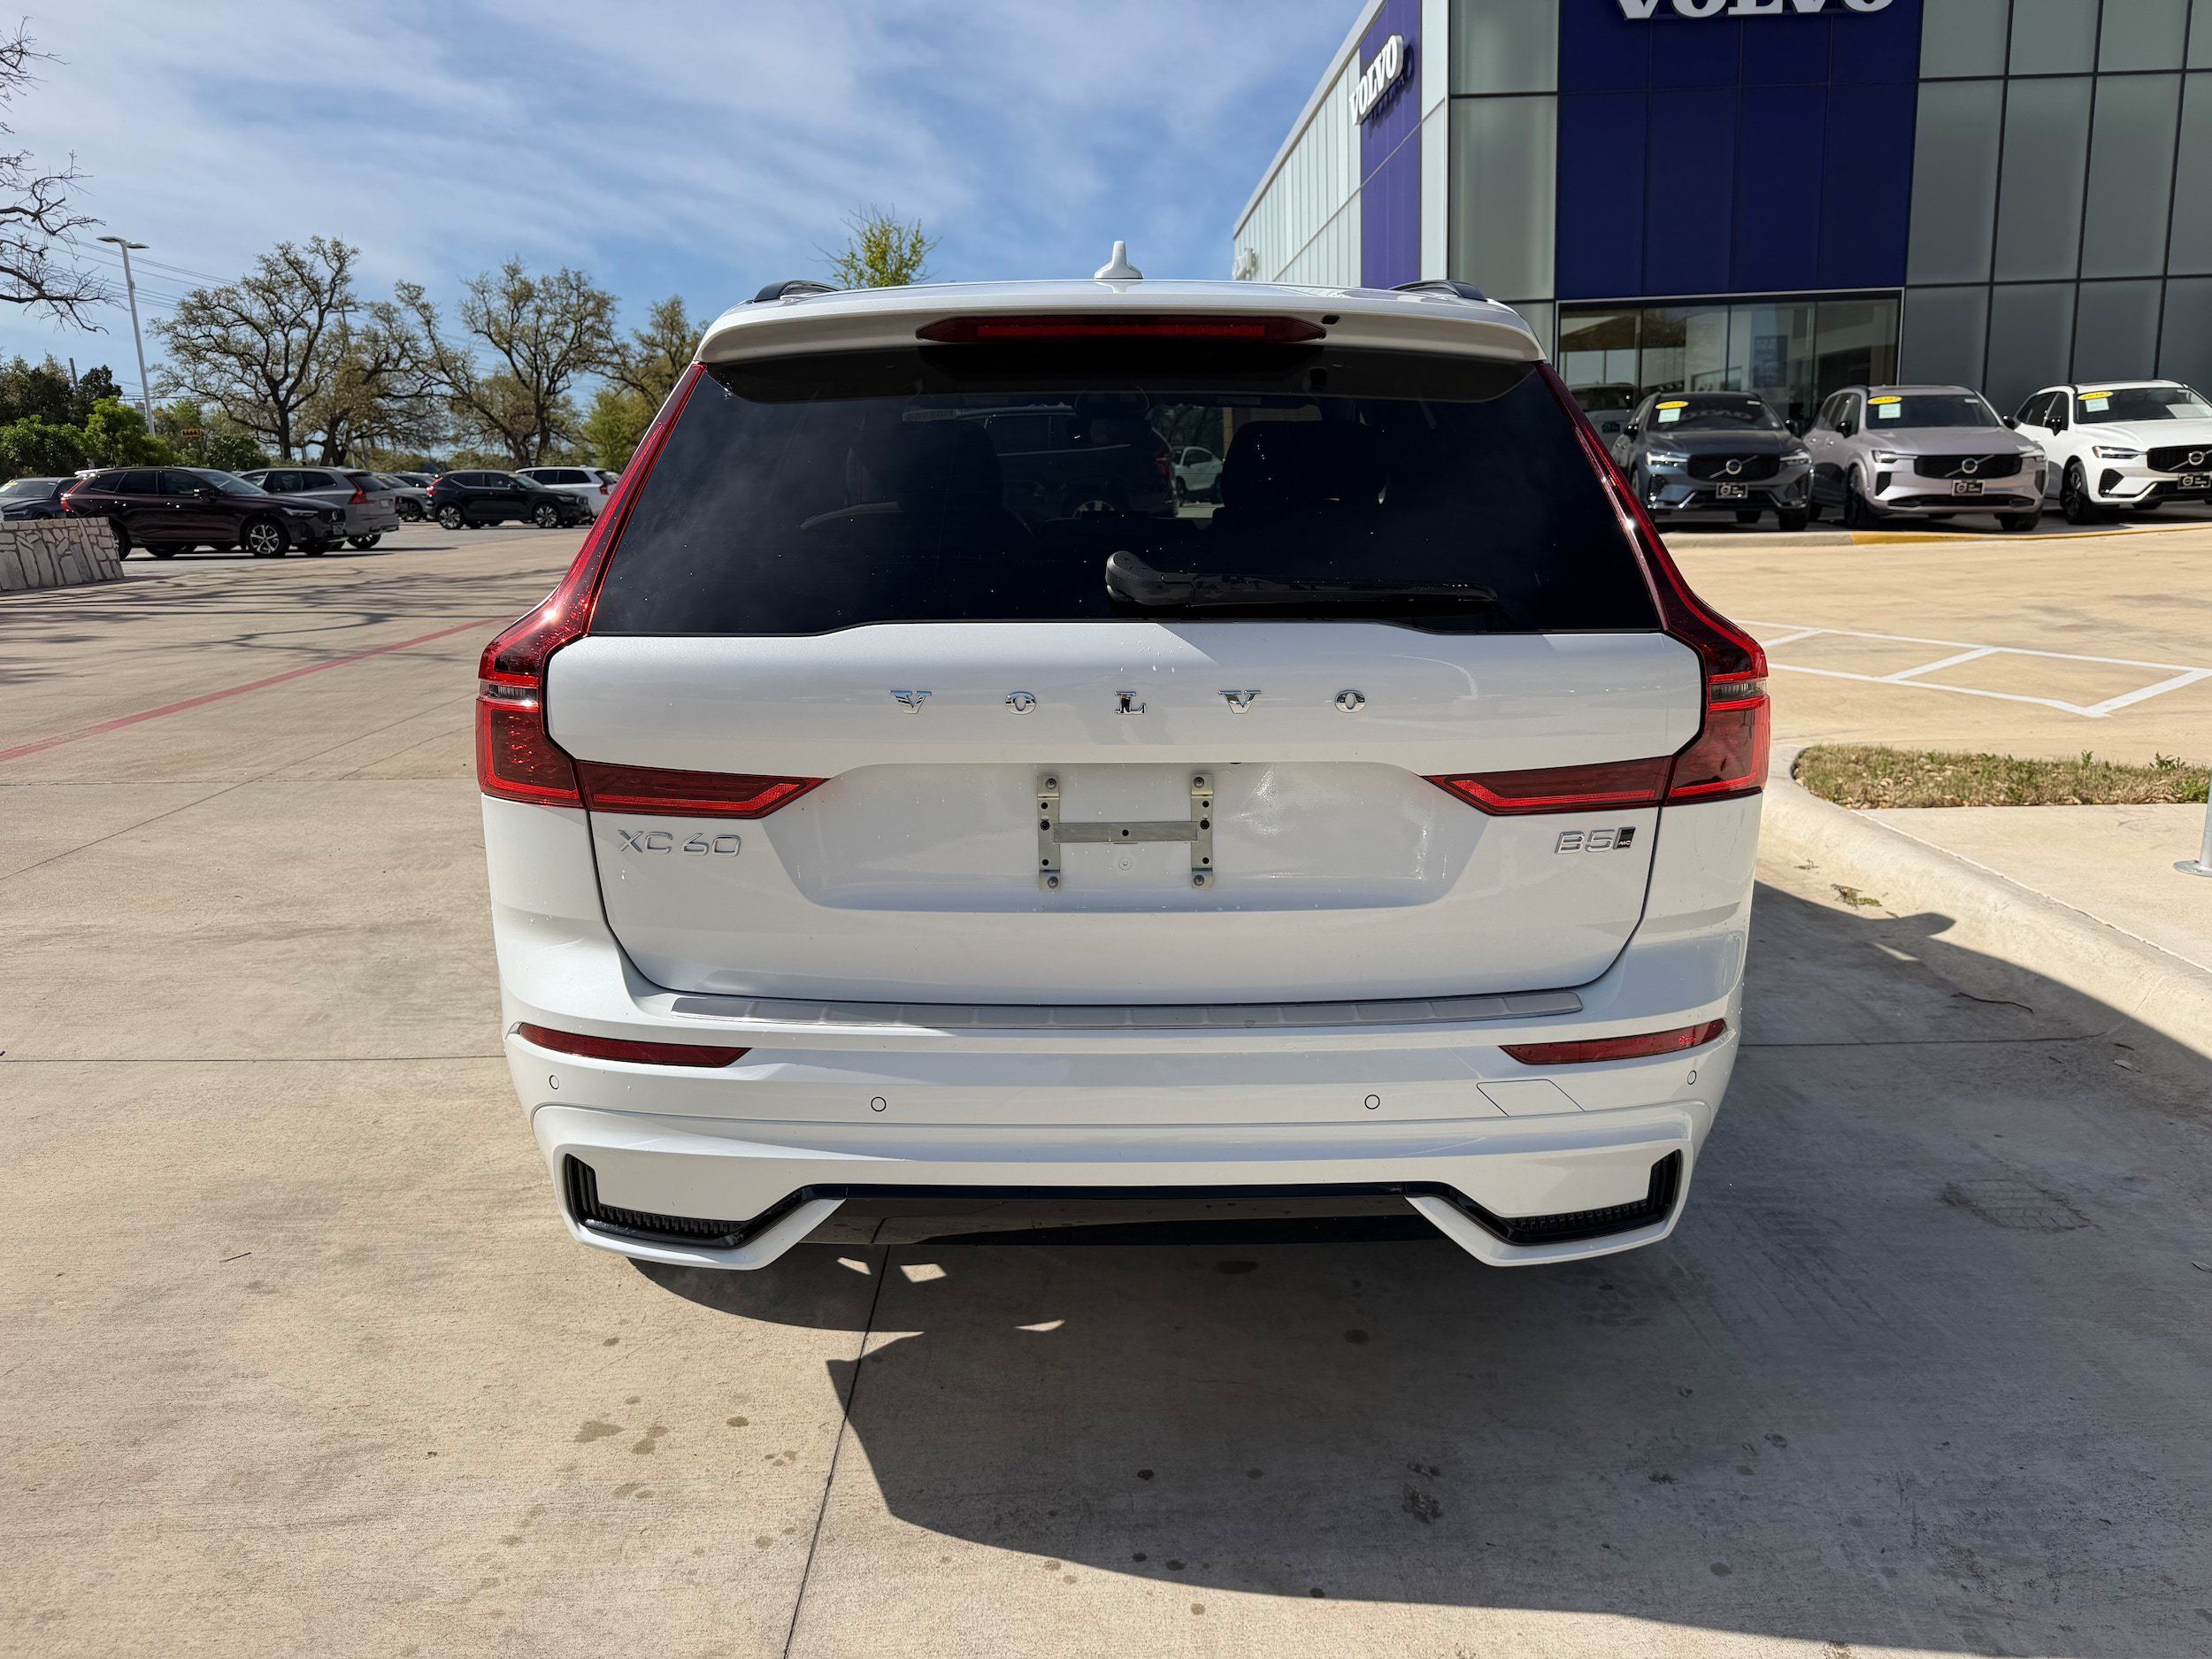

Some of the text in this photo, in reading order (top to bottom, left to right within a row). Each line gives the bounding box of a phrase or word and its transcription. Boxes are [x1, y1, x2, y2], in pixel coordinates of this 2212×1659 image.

[1348, 35, 1403, 126] VOLVO
[888, 689, 1366, 715] VOLVO
[1555, 828, 1615, 855] B5
